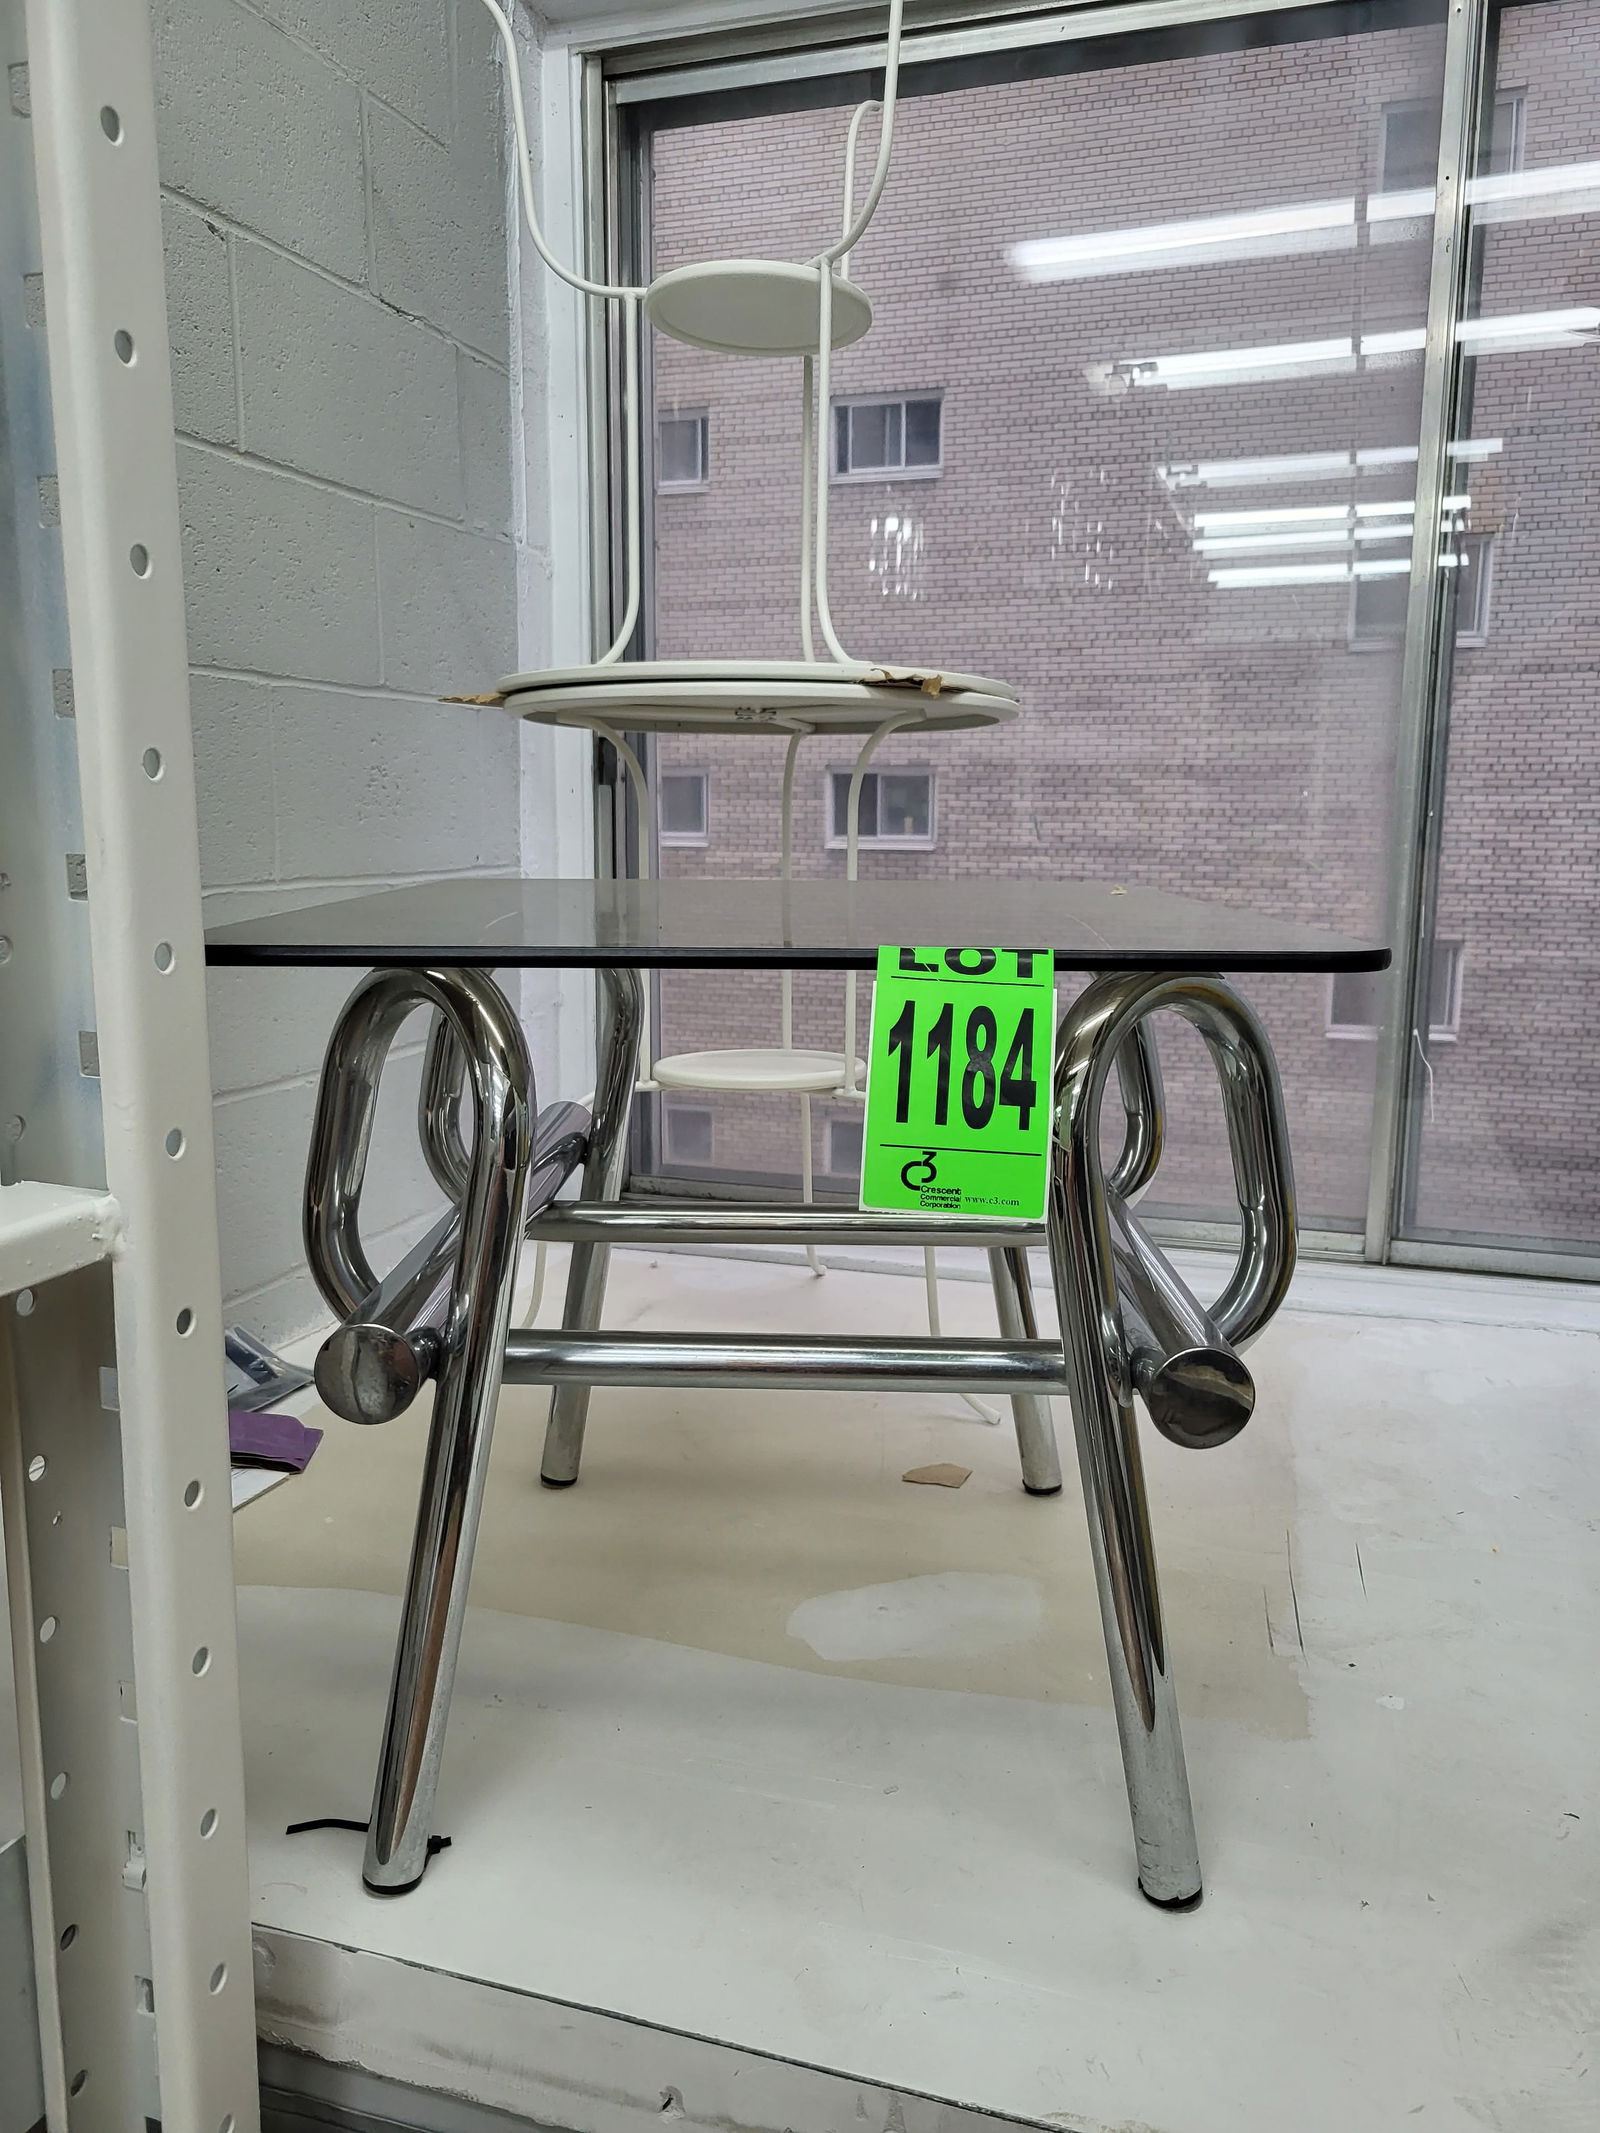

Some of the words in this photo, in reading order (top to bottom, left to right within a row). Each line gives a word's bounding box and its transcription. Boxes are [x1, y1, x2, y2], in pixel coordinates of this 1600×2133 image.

[899, 947, 1049, 979] LOT
[888, 1000, 1037, 1131] 1184
[920, 1185, 962, 1196] Crescent
[920, 1193, 961, 1203] Commercial
[964, 1196, 1020, 1207] www.c3.com
[919, 1201, 961, 1209] Corporation
